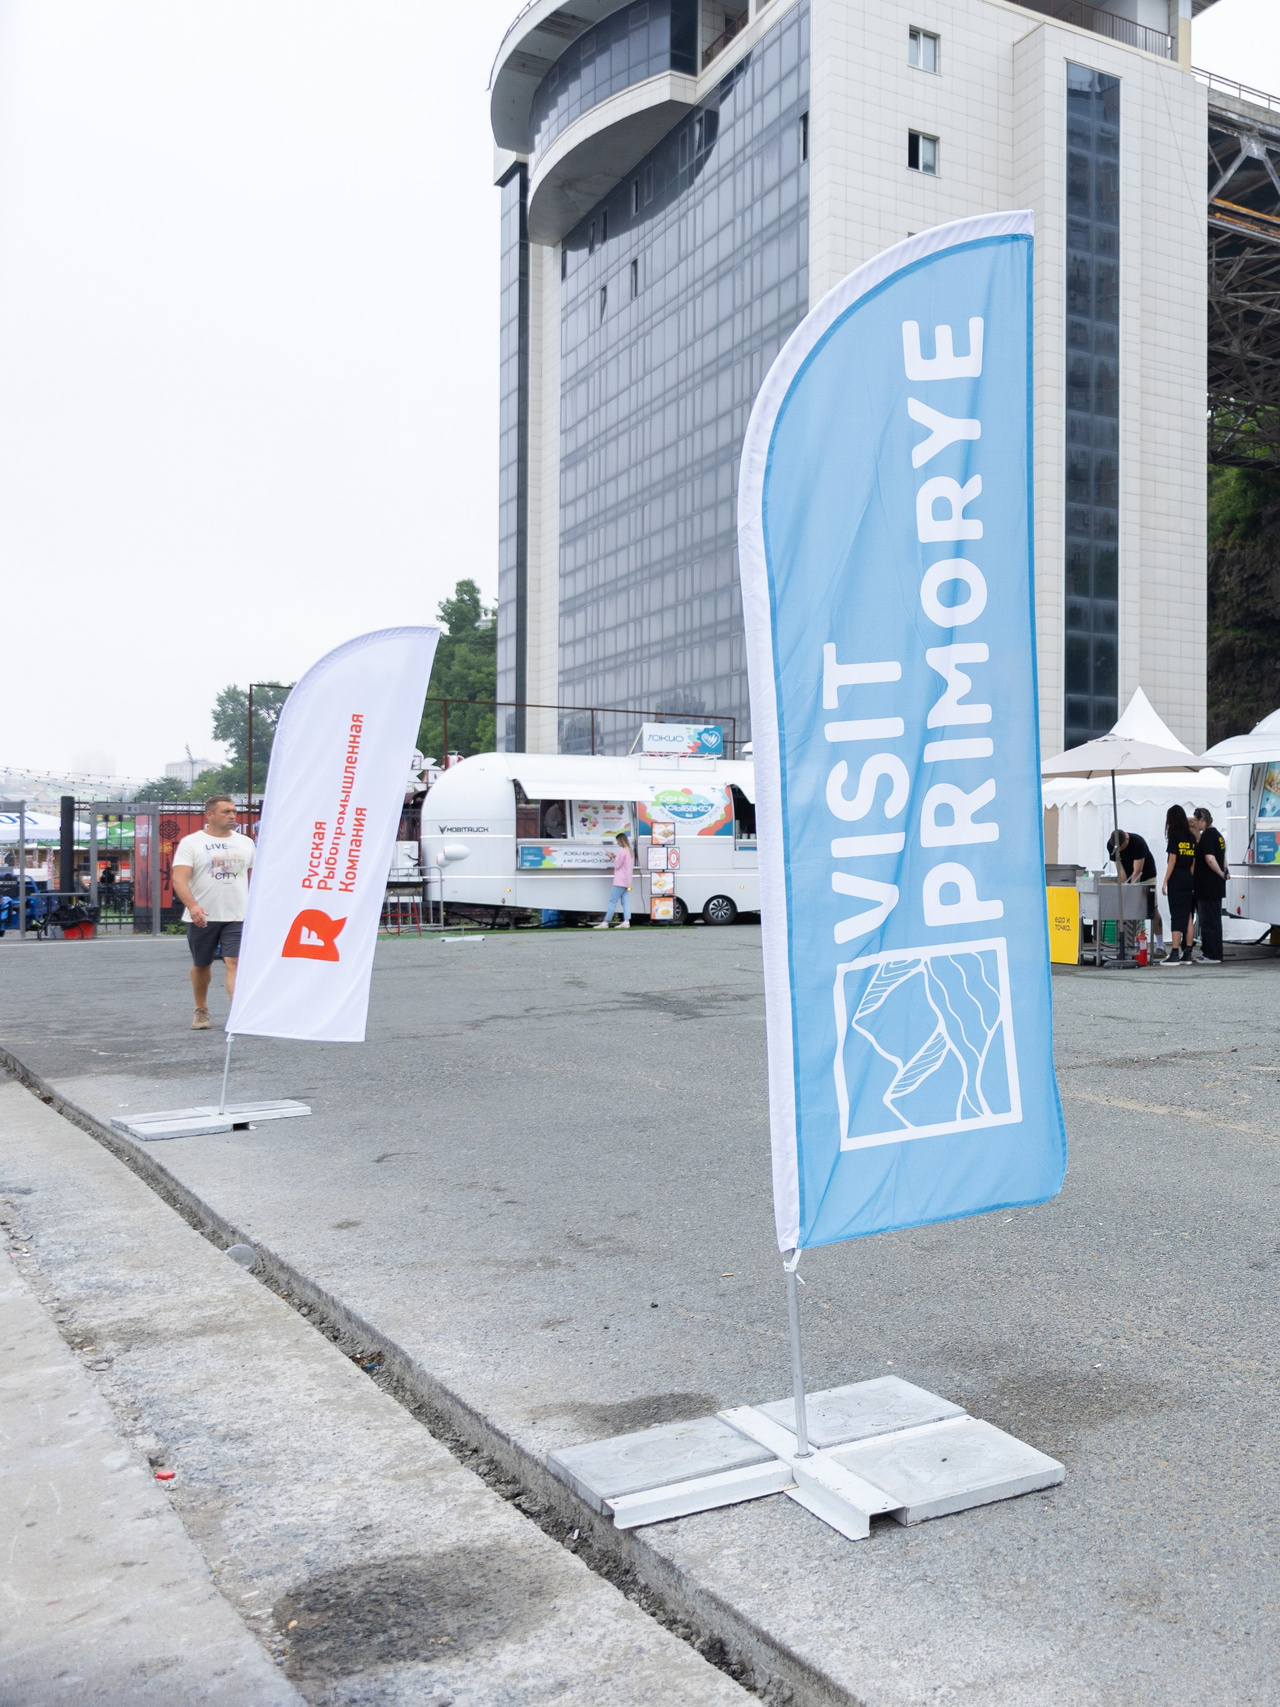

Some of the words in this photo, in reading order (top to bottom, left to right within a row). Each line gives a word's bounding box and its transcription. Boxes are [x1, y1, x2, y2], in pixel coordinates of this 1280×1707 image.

[901, 315, 1005, 931] PRIMORYE
[316, 713, 364, 891] Рыбопромышленная
[821, 641, 910, 946] VISIT
[205, 842, 228, 850] LIVE
[214, 872, 238, 881] CITY
[301, 820, 327, 889] Русская
[338, 806, 368, 893] Компания
